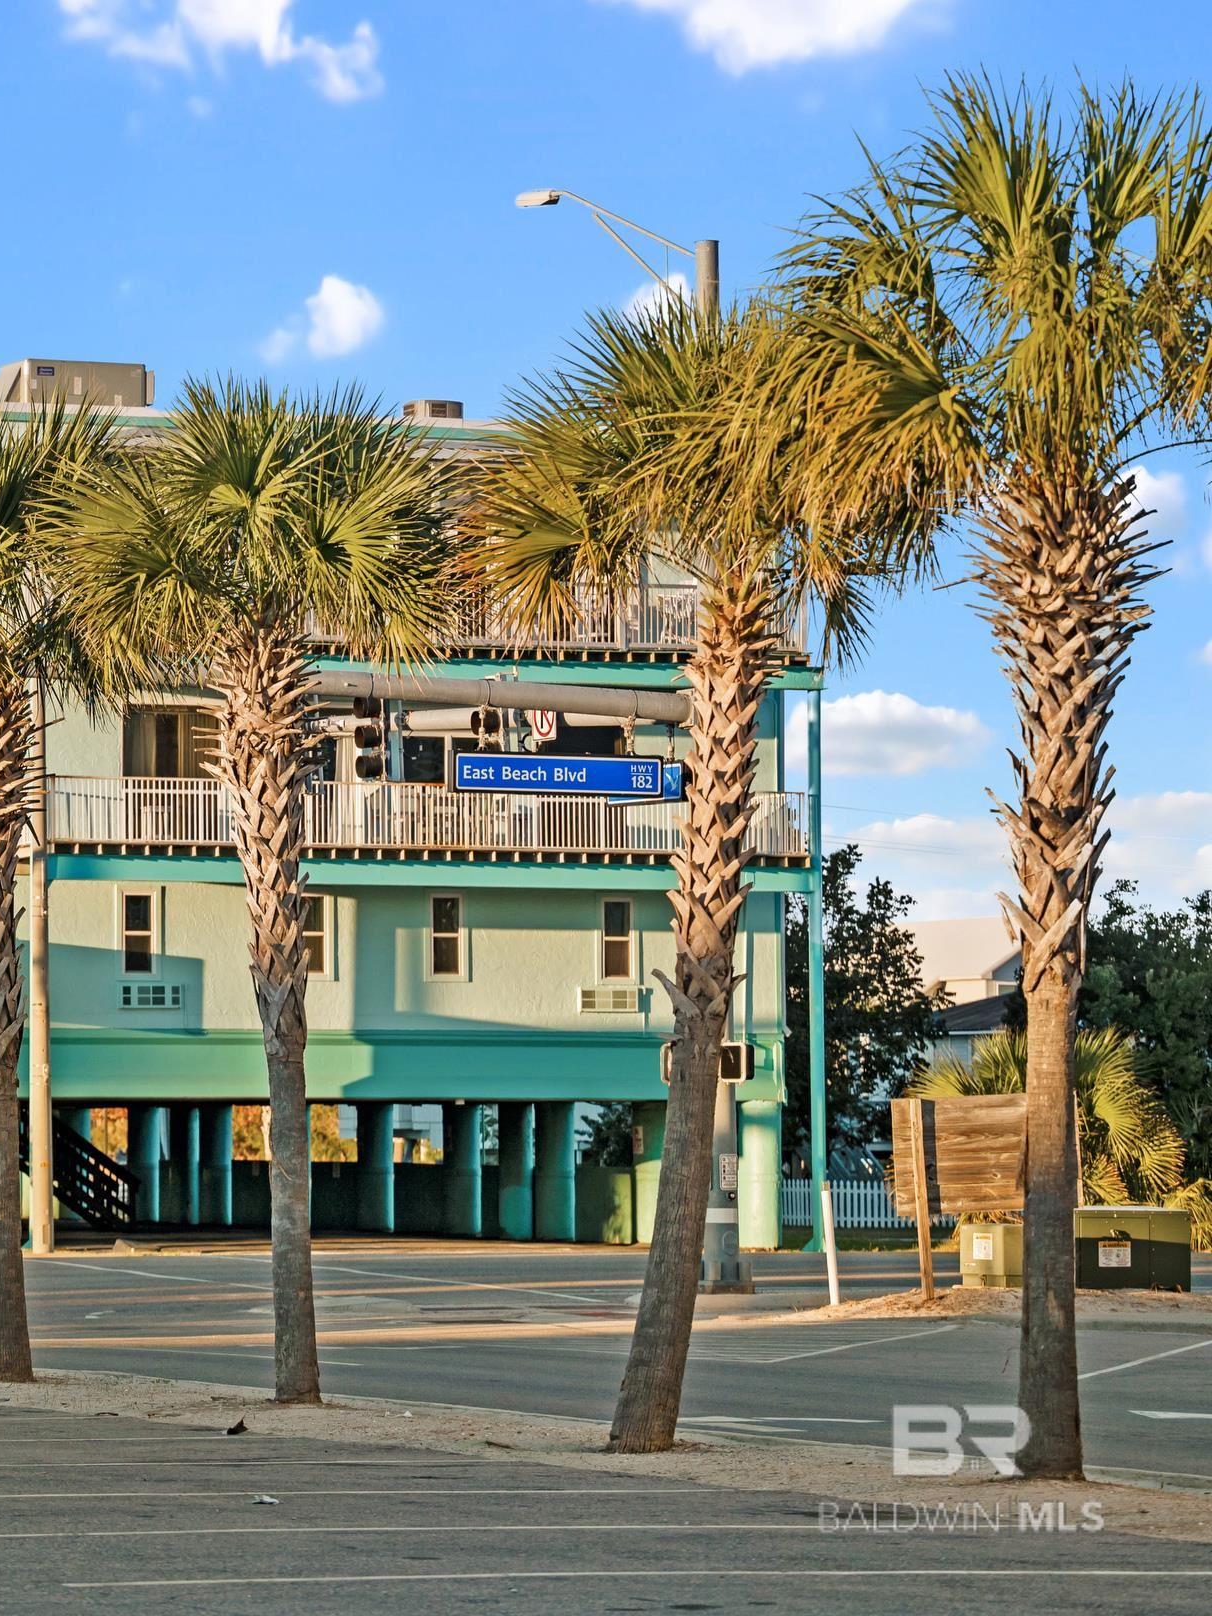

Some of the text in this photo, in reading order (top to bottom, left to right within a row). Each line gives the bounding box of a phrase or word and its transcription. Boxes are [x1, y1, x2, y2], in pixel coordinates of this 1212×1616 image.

[462, 765, 587, 783] East Beach Blvd
[630, 764, 653, 773] HWY
[631, 775, 653, 788] 182
